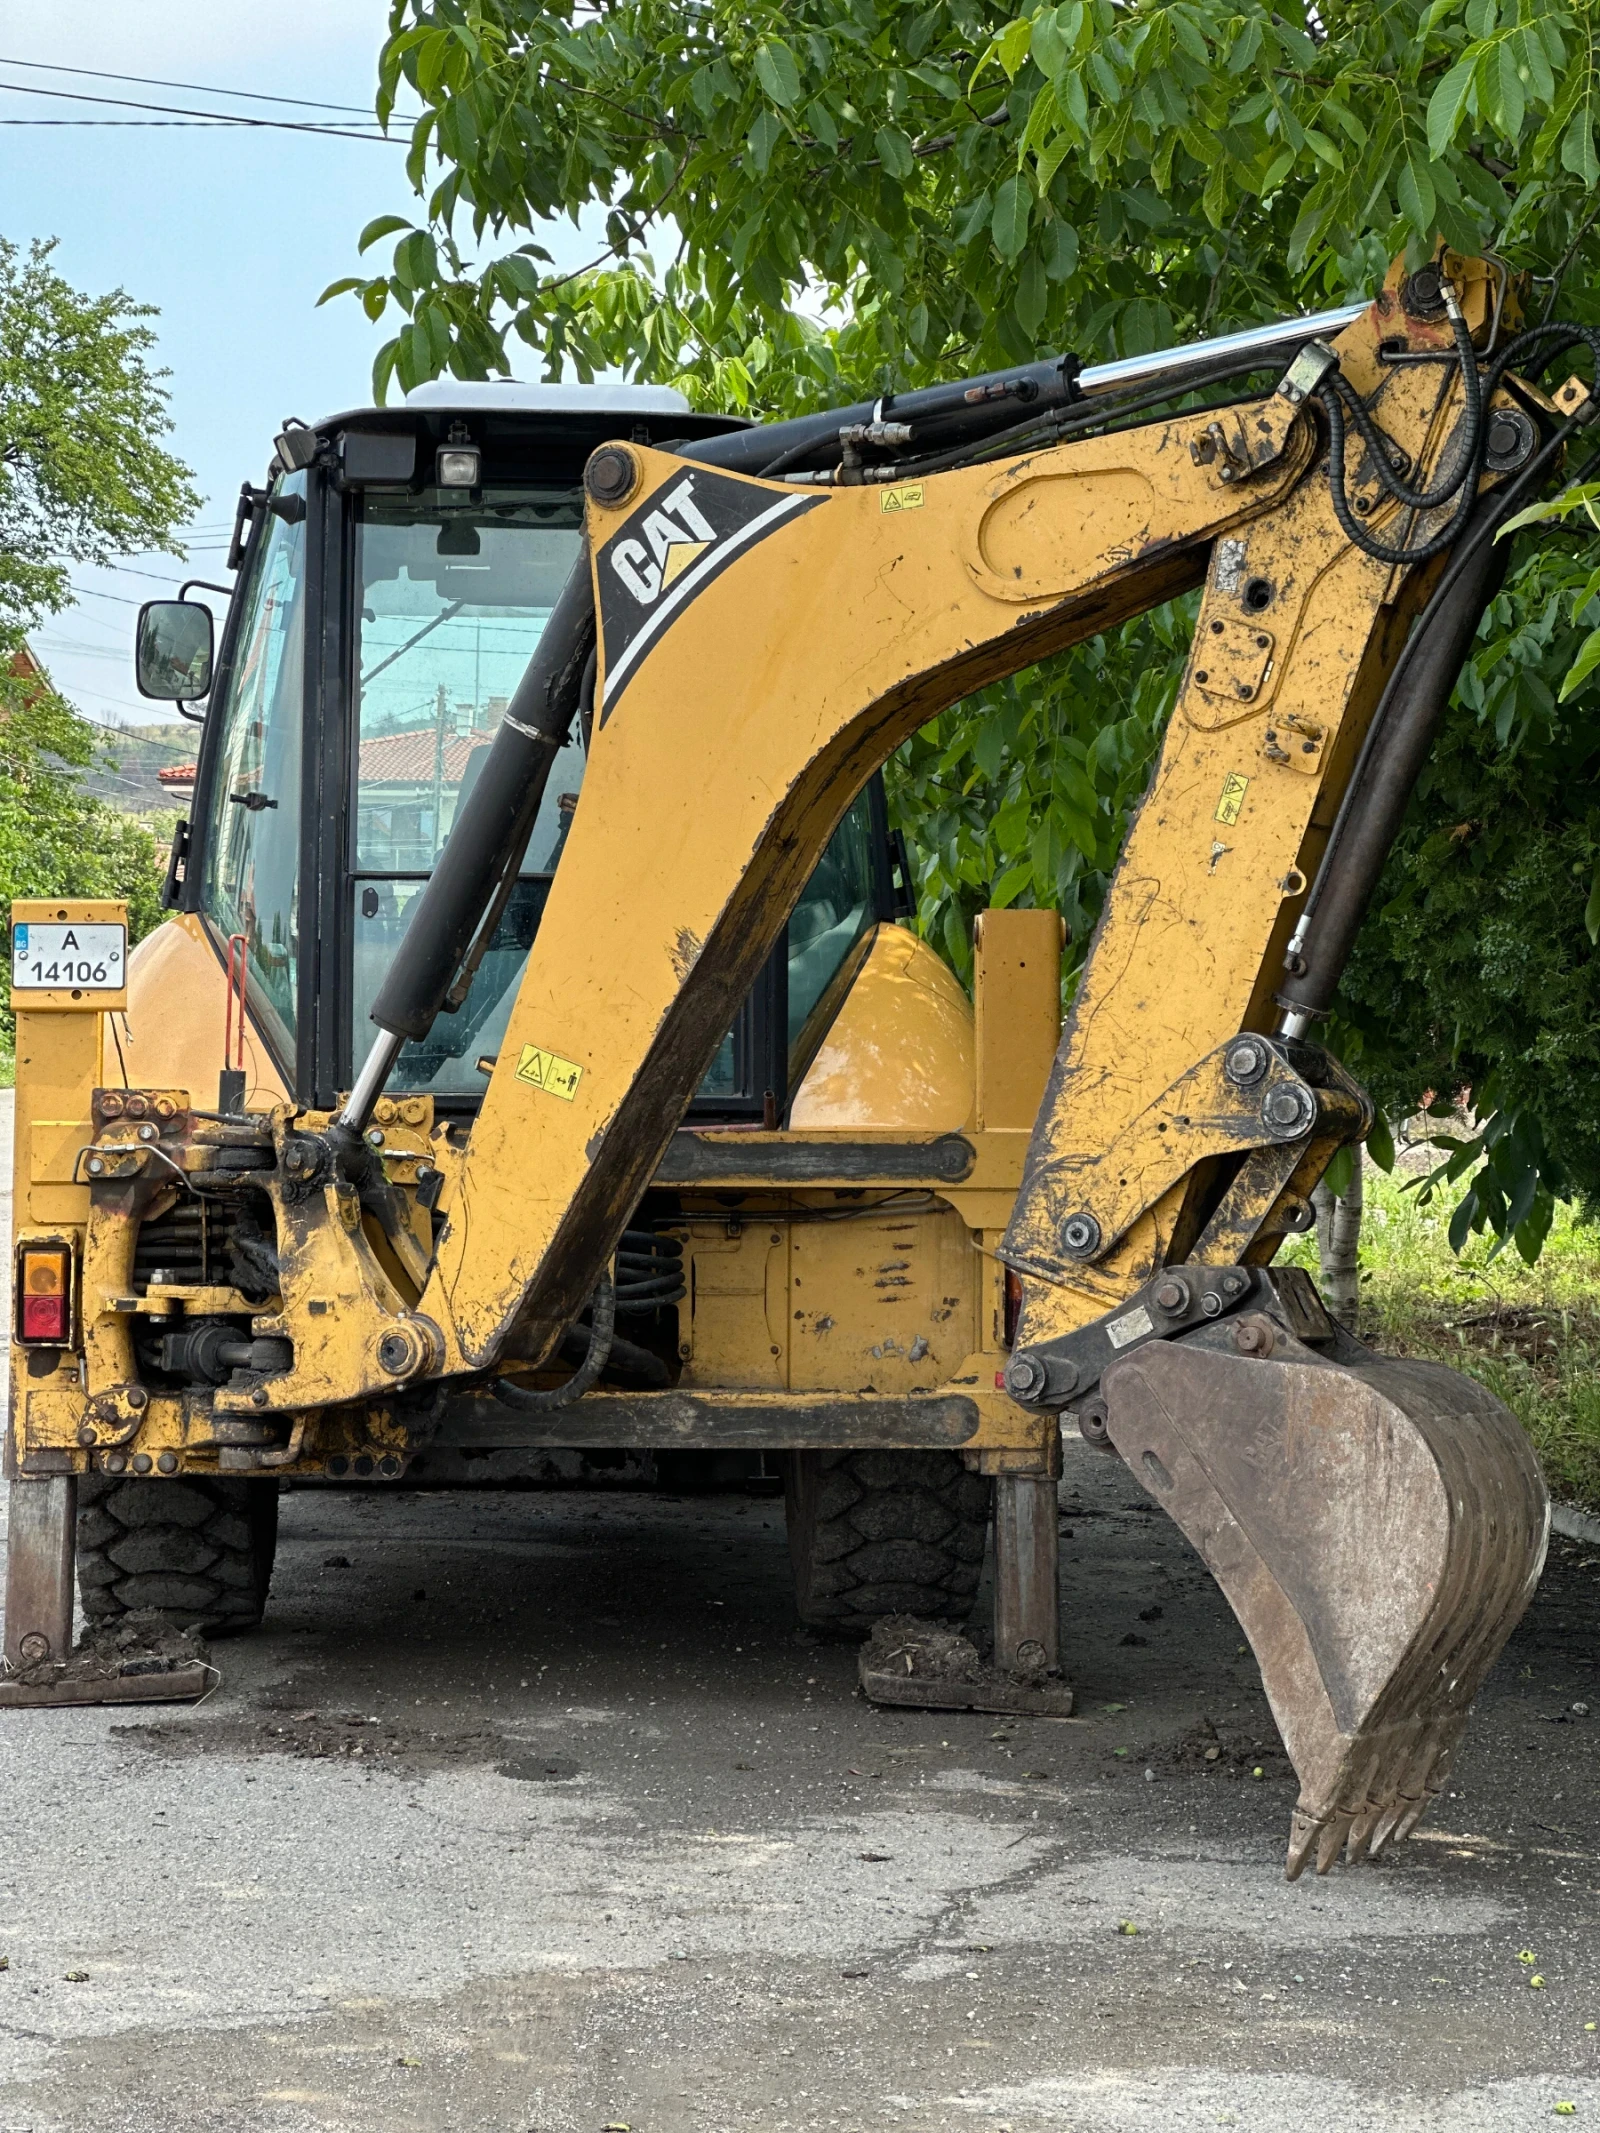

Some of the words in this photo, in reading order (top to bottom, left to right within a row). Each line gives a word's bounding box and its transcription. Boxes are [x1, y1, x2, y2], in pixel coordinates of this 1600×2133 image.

[611, 478, 718, 604] CAT
[61, 930, 80, 950] A
[31, 962, 107, 982] 14106
